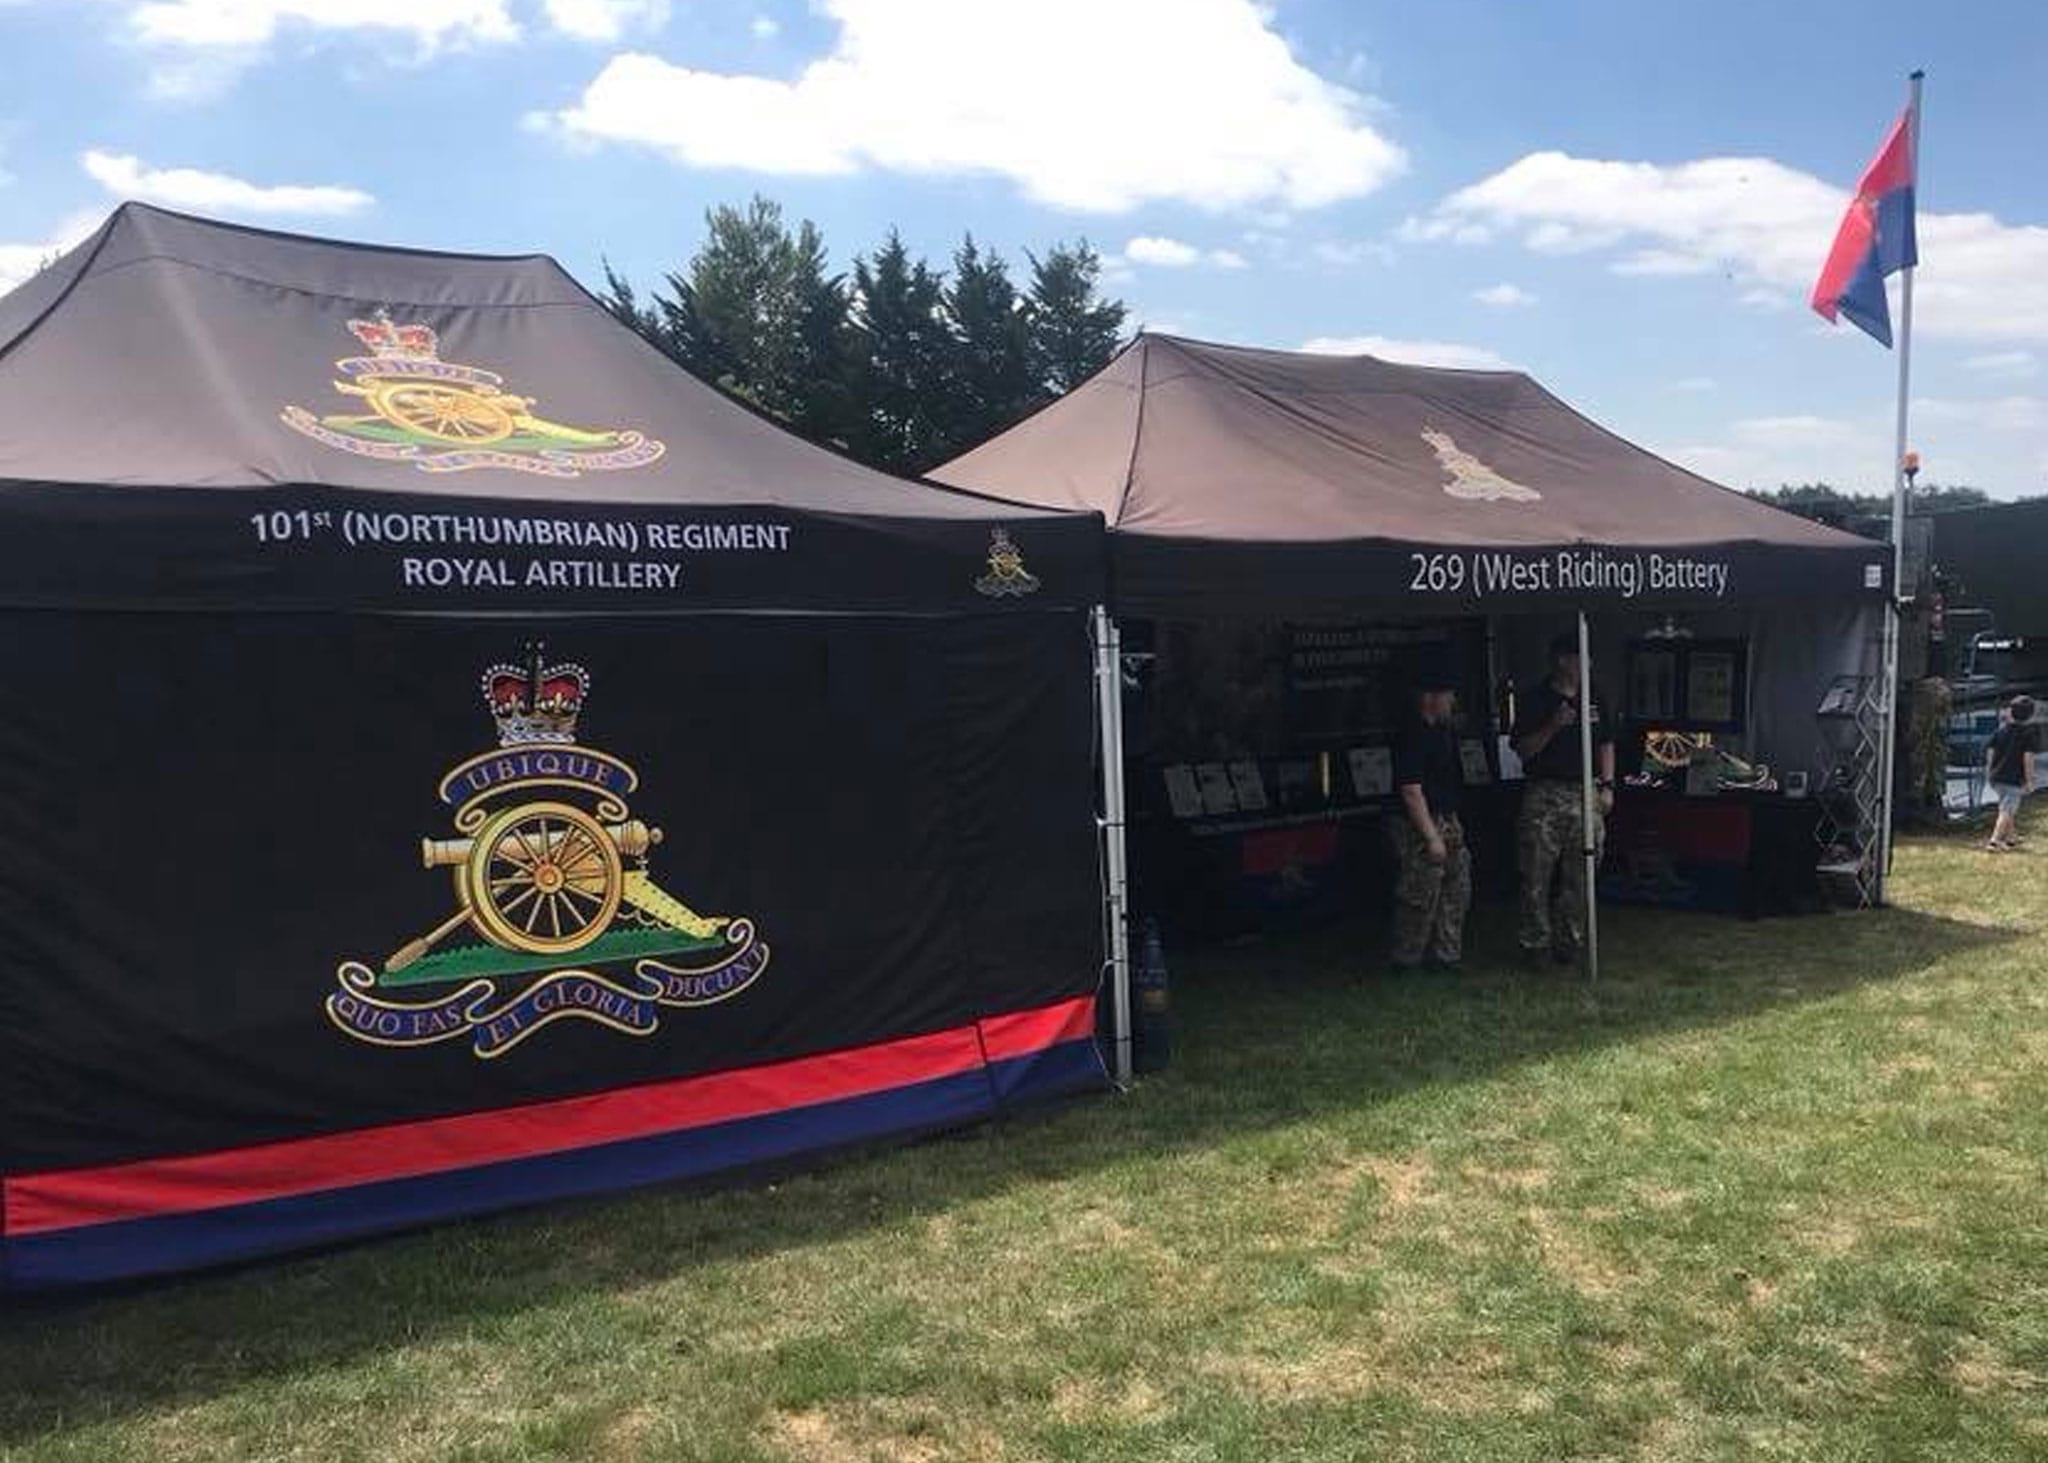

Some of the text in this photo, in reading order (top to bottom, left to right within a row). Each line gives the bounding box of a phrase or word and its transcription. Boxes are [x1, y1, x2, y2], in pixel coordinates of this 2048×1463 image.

[250, 510, 790, 553] 101st (NORTHUMBRIAN) REGIMENT
[403, 557, 681, 590] ROYAL ARTILLERY
[1410, 553, 1729, 598] 269 (West Riding) Battery
[466, 750, 613, 792] UBIQUE
[335, 993, 400, 1036] QUO
[488, 1013, 525, 1047] ET
[534, 980, 645, 1027] GLORIA
[667, 945, 767, 997] DUCUNT
